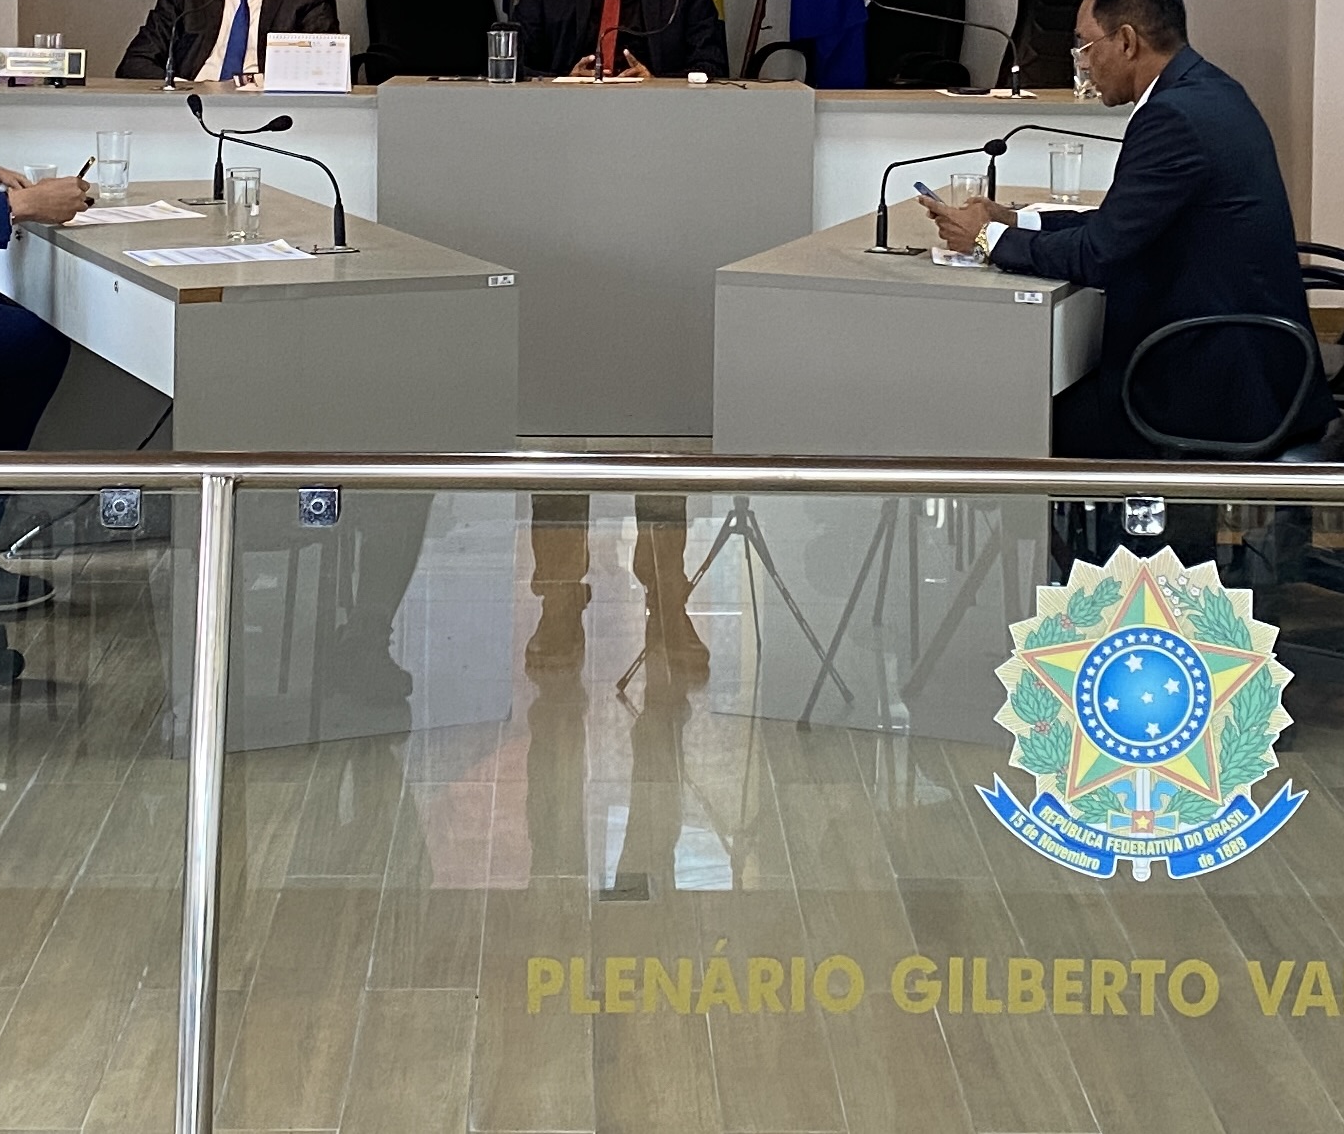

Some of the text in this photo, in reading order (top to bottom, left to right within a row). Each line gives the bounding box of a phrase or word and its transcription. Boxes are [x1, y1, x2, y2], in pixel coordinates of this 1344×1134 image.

[1009, 810, 1101, 871] 15 de Novembro
[1106, 838, 1183, 855] FEDERATIVA
[1184, 830, 1203, 850] DO
[1203, 808, 1248, 844] BRASIL
[1197, 836, 1248, 868] de 1889
[527, 939, 865, 1016] PLENÁRIO
[891, 956, 1219, 1017] GILBERTO
